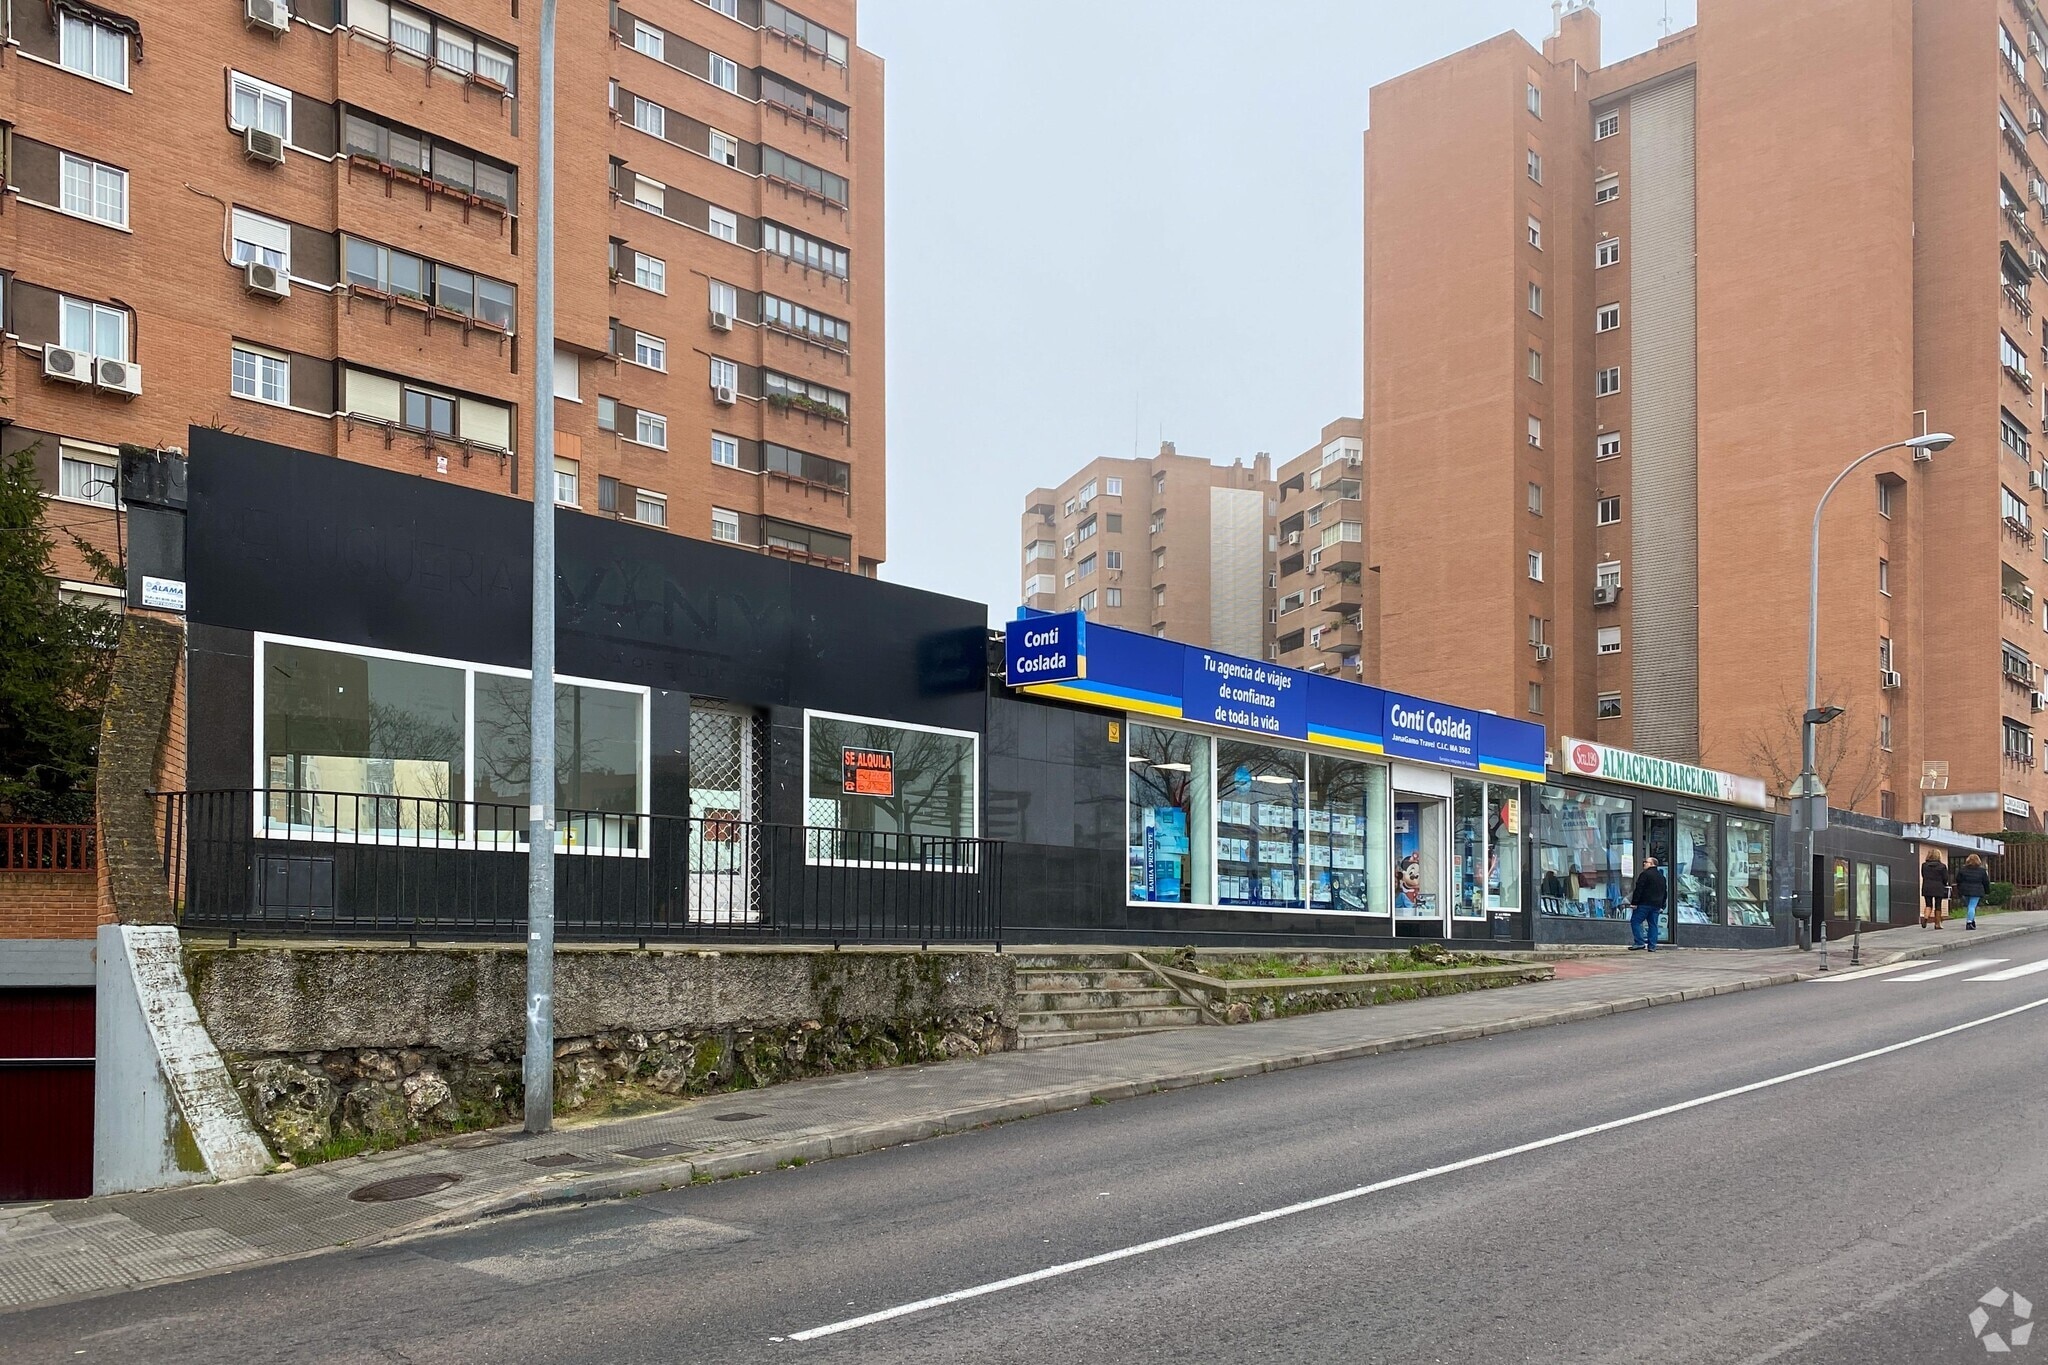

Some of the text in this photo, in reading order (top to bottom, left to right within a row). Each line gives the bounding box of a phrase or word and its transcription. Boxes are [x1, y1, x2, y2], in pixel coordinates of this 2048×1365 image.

[1024, 627, 1059, 647] Conti
[1016, 652, 1067, 673] Coslada
[1204, 655, 1292, 691] Tu agencia de viajes
[1219, 683, 1276, 708] de confianza
[1214, 706, 1279, 731] de toda la vida
[1391, 703, 1472, 741] Conti Coslada
[1419, 738, 1435, 748] Travel
[845, 751, 891, 769] SE ALQUILA
[1602, 748, 1664, 787] ALMACENES
[1666, 762, 1720, 798] BARCELONA
